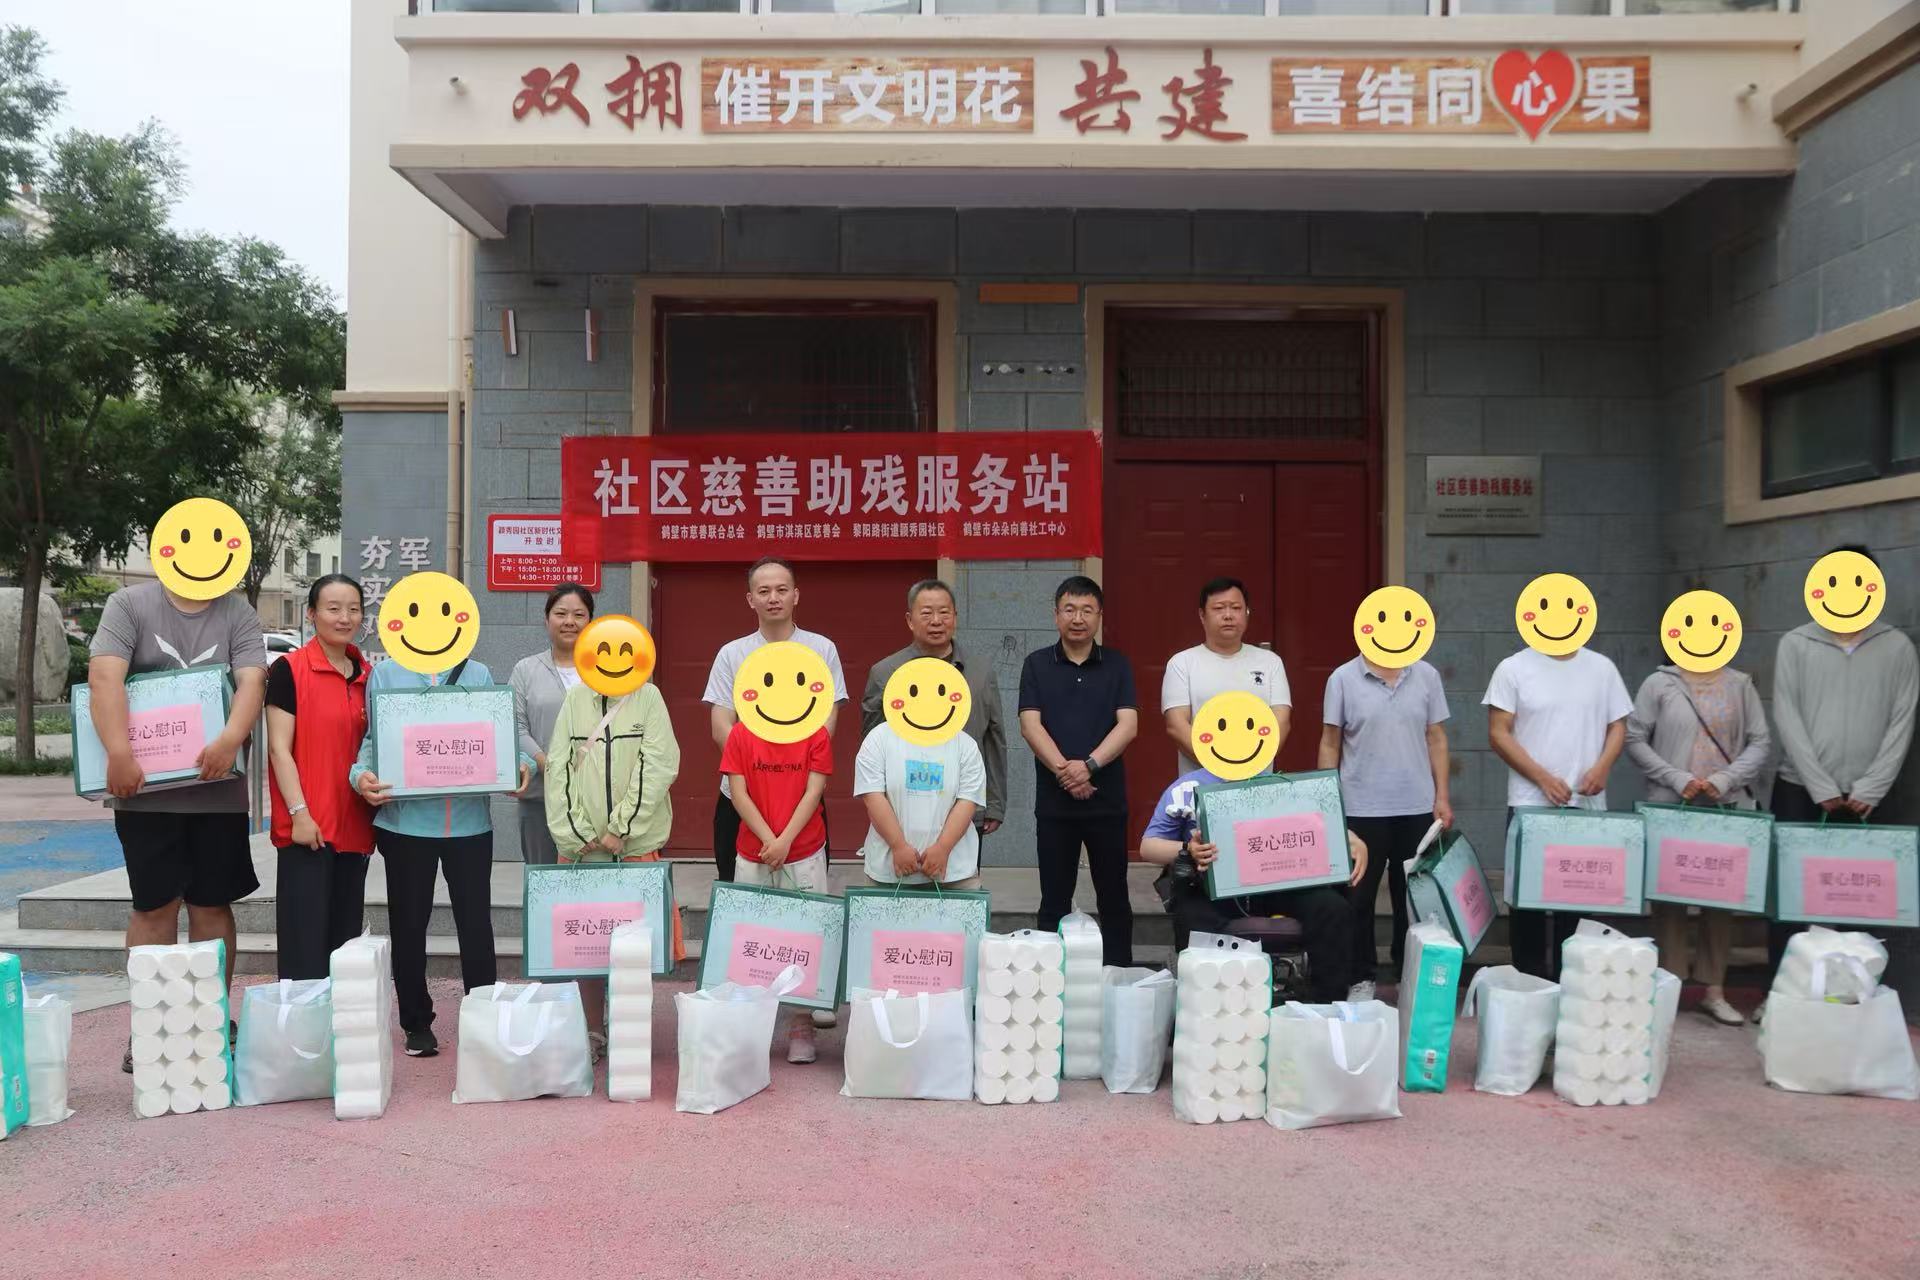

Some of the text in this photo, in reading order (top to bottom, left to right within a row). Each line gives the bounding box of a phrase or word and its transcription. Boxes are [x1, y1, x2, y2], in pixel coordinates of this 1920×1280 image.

[512, 55, 683, 130] 双拥
[714, 67, 1023, 125] 催开文明花
[1059, 46, 1249, 141] 共建
[1288, 66, 1640, 125] 喜结同心果
[593, 453, 1071, 518] 社区慈善助残服务站
[524, 537, 562, 546] 开放时
[661, 524, 745, 540] 鹤壁市慈善联合总会
[756, 523, 841, 540] 鹤壁市淇滨区慈善会
[963, 521, 1066, 537] 鹤壁市朵朵向善社工中心
[415, 738, 485, 756] 爱心慰问
[1247, 830, 1315, 854] 爱心慰问
[1558, 858, 1613, 876] 爱心慰问
[1674, 854, 1734, 873] 爱心慰问
[1819, 872, 1882, 888] 爱心慰问
[742, 939, 811, 967] 爱心慰问
[884, 946, 954, 967] 爱心慰问
